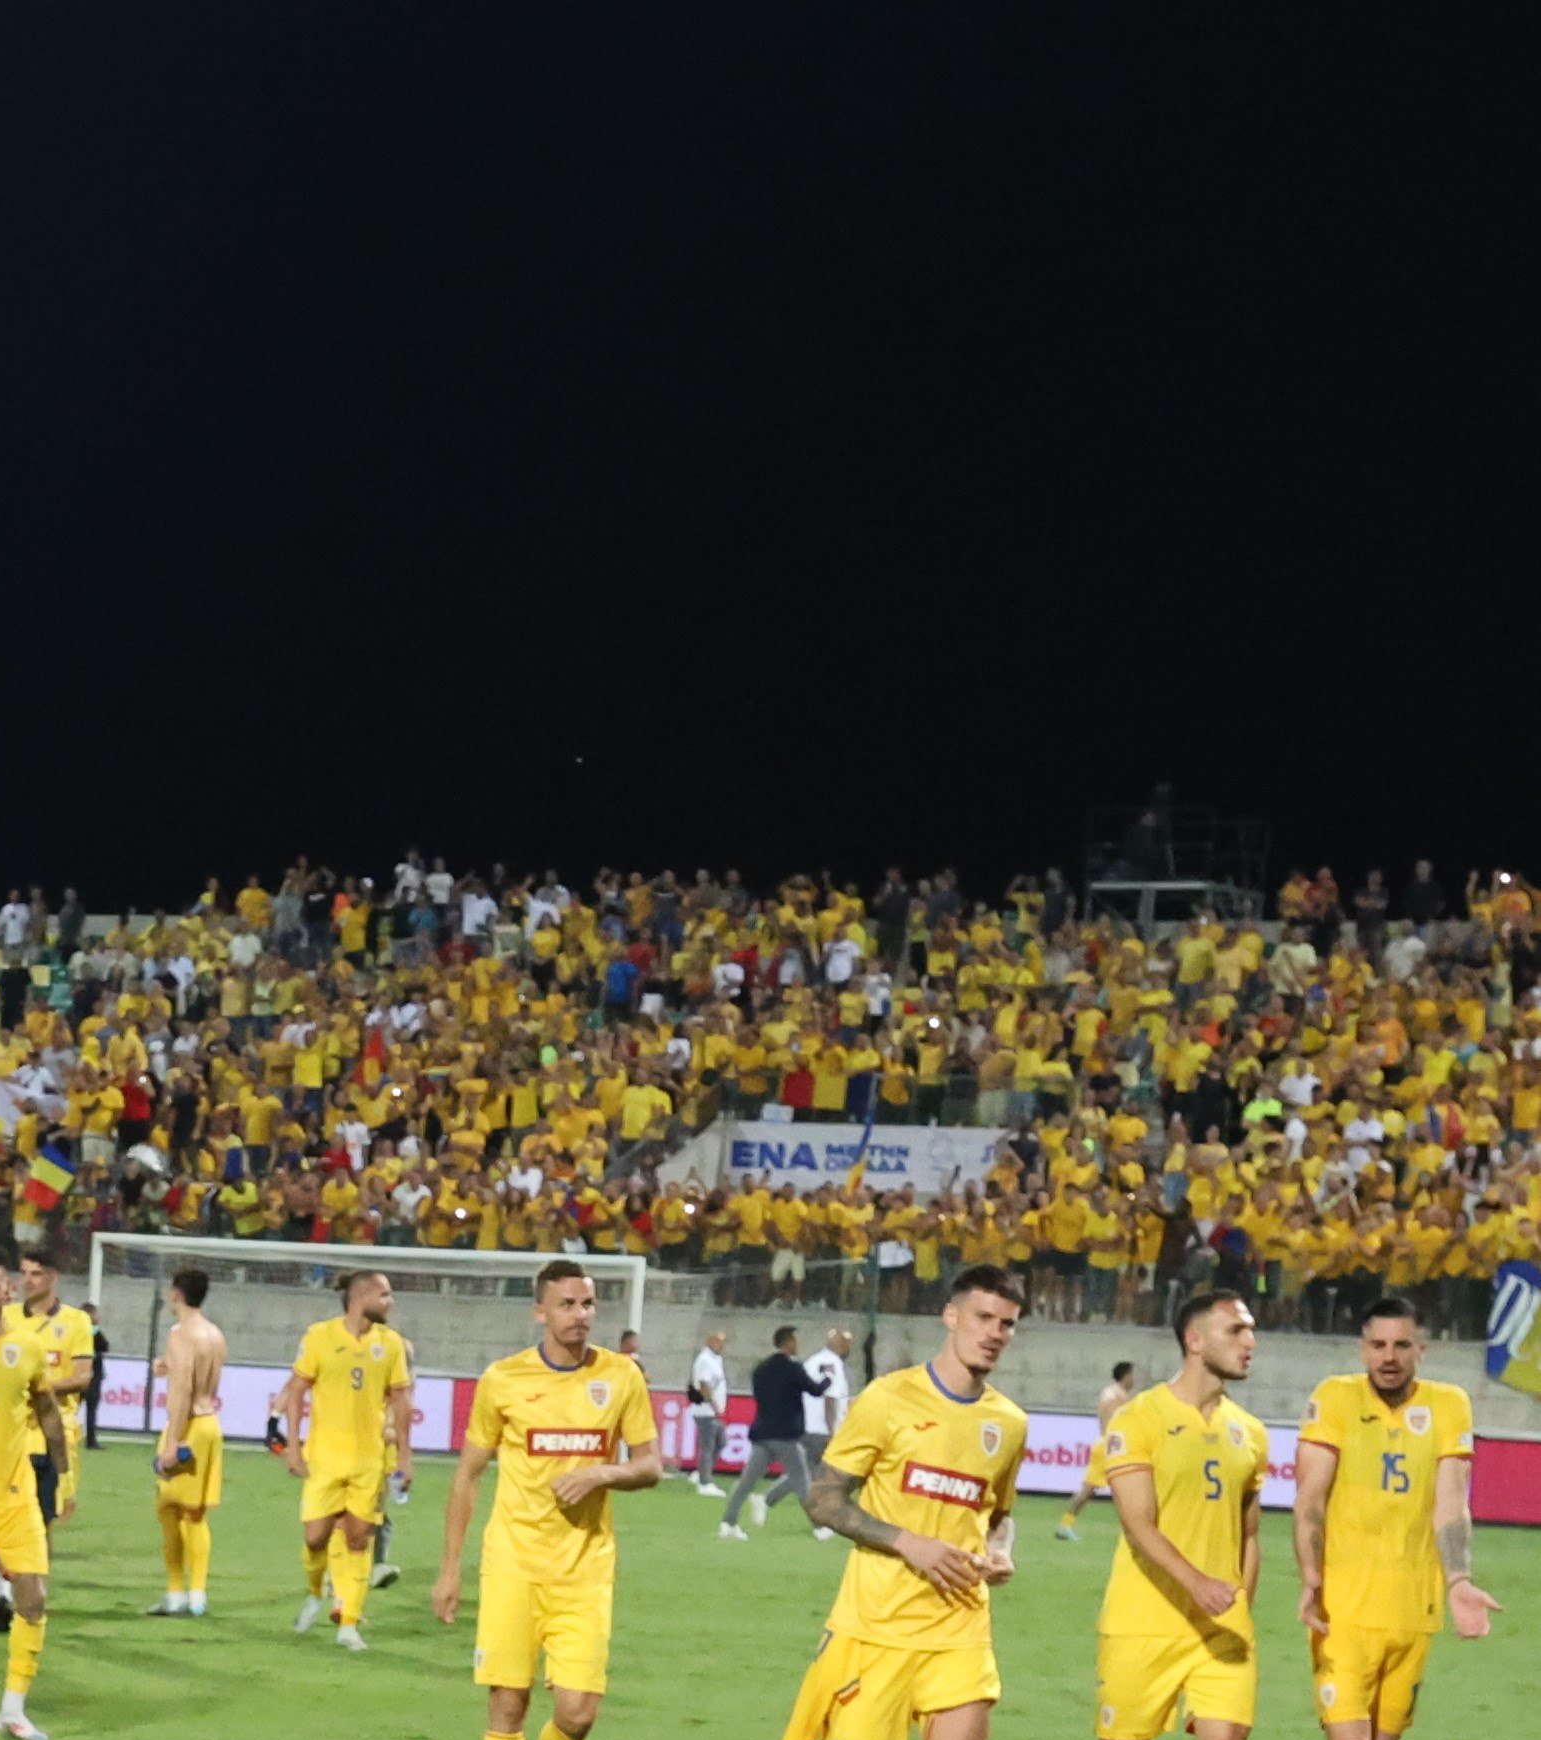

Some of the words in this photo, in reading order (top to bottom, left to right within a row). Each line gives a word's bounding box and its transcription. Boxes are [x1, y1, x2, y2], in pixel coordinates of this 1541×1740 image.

[350, 1366, 365, 1391] 9
[1203, 1459, 1223, 1500] 5
[1380, 1452, 1411, 1494] 15
